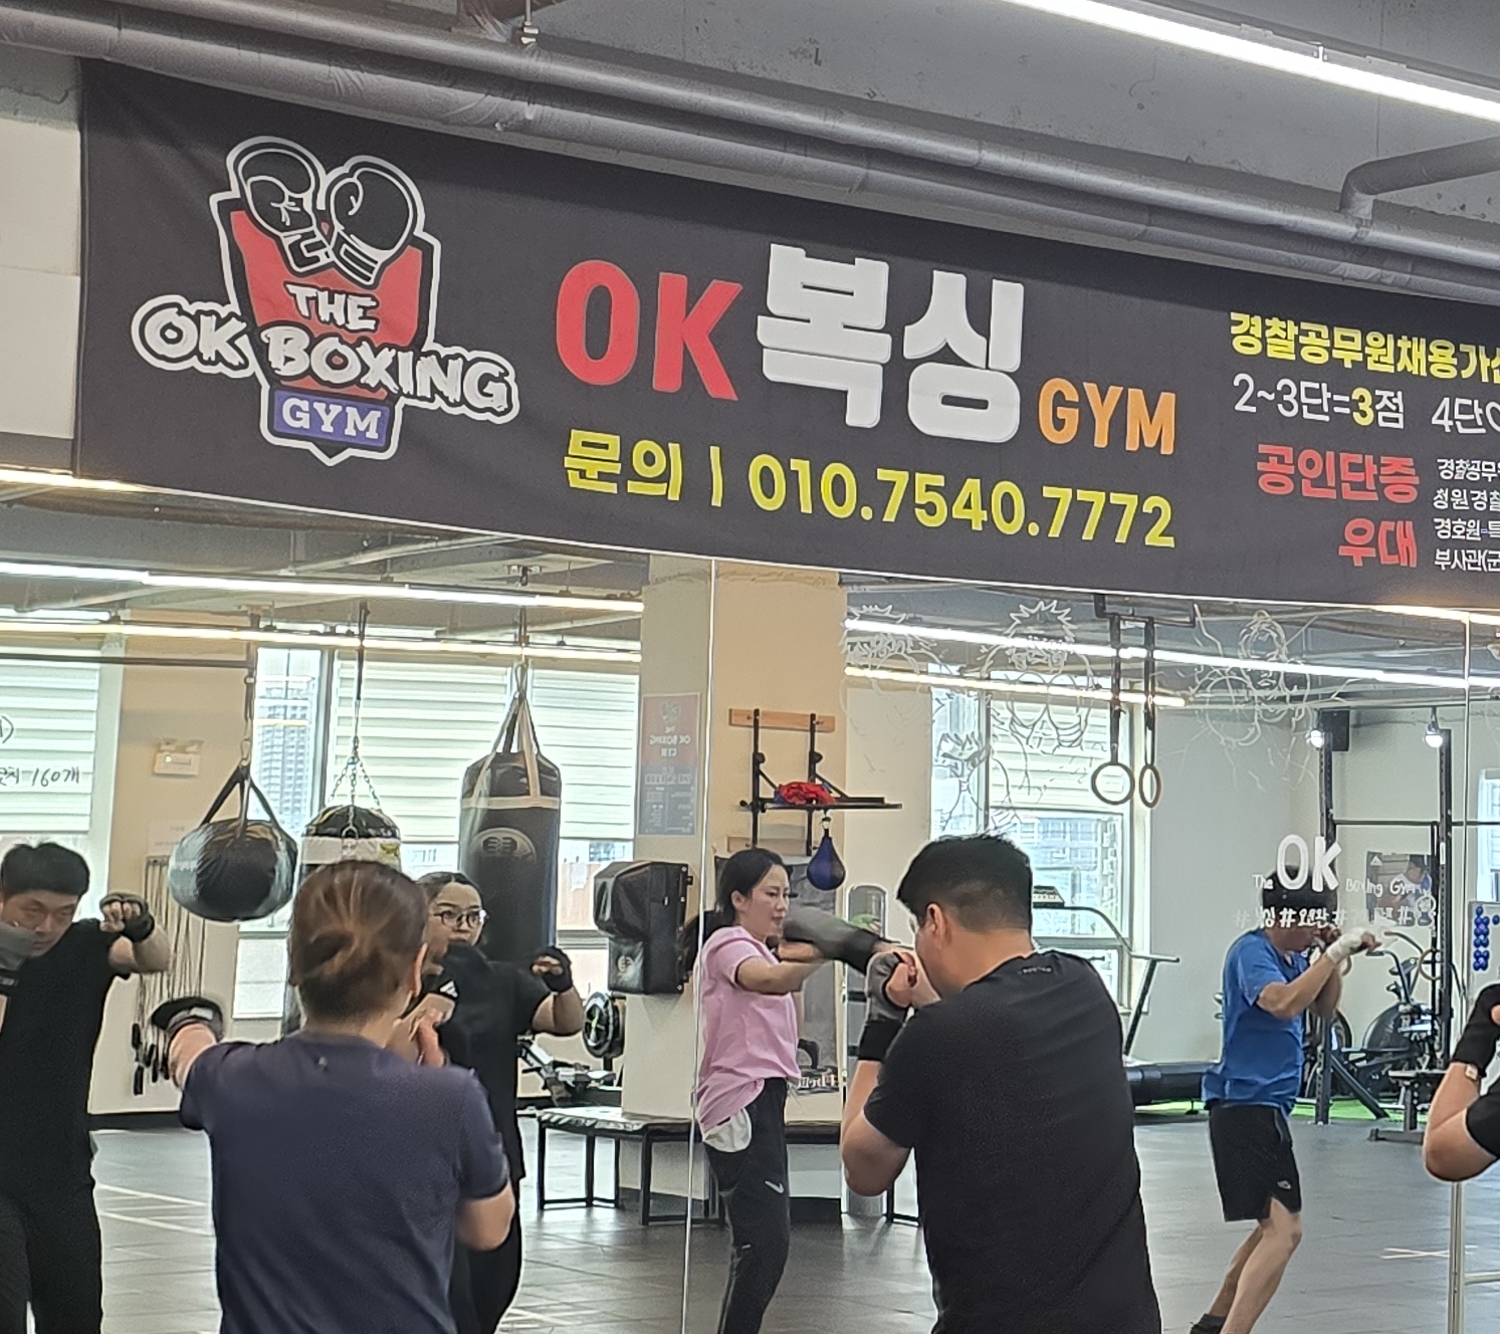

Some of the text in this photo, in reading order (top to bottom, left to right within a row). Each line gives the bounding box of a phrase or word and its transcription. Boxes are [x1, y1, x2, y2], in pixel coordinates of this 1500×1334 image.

[286, 283, 379, 329] THE
[141, 304, 512, 416] OK BOXING
[555, 243, 1177, 455] OK 복싱 GYM
[282, 400, 383, 443] GYM
[1233, 373, 1406, 430] 2~3단=3점
[564, 428, 684, 502] 문의
[748, 453, 1176, 549] 010.7540.7772
[1255, 443, 1420, 504] 공인단증
[1337, 517, 1419, 568] 우대
[1277, 834, 1342, 893] OK
